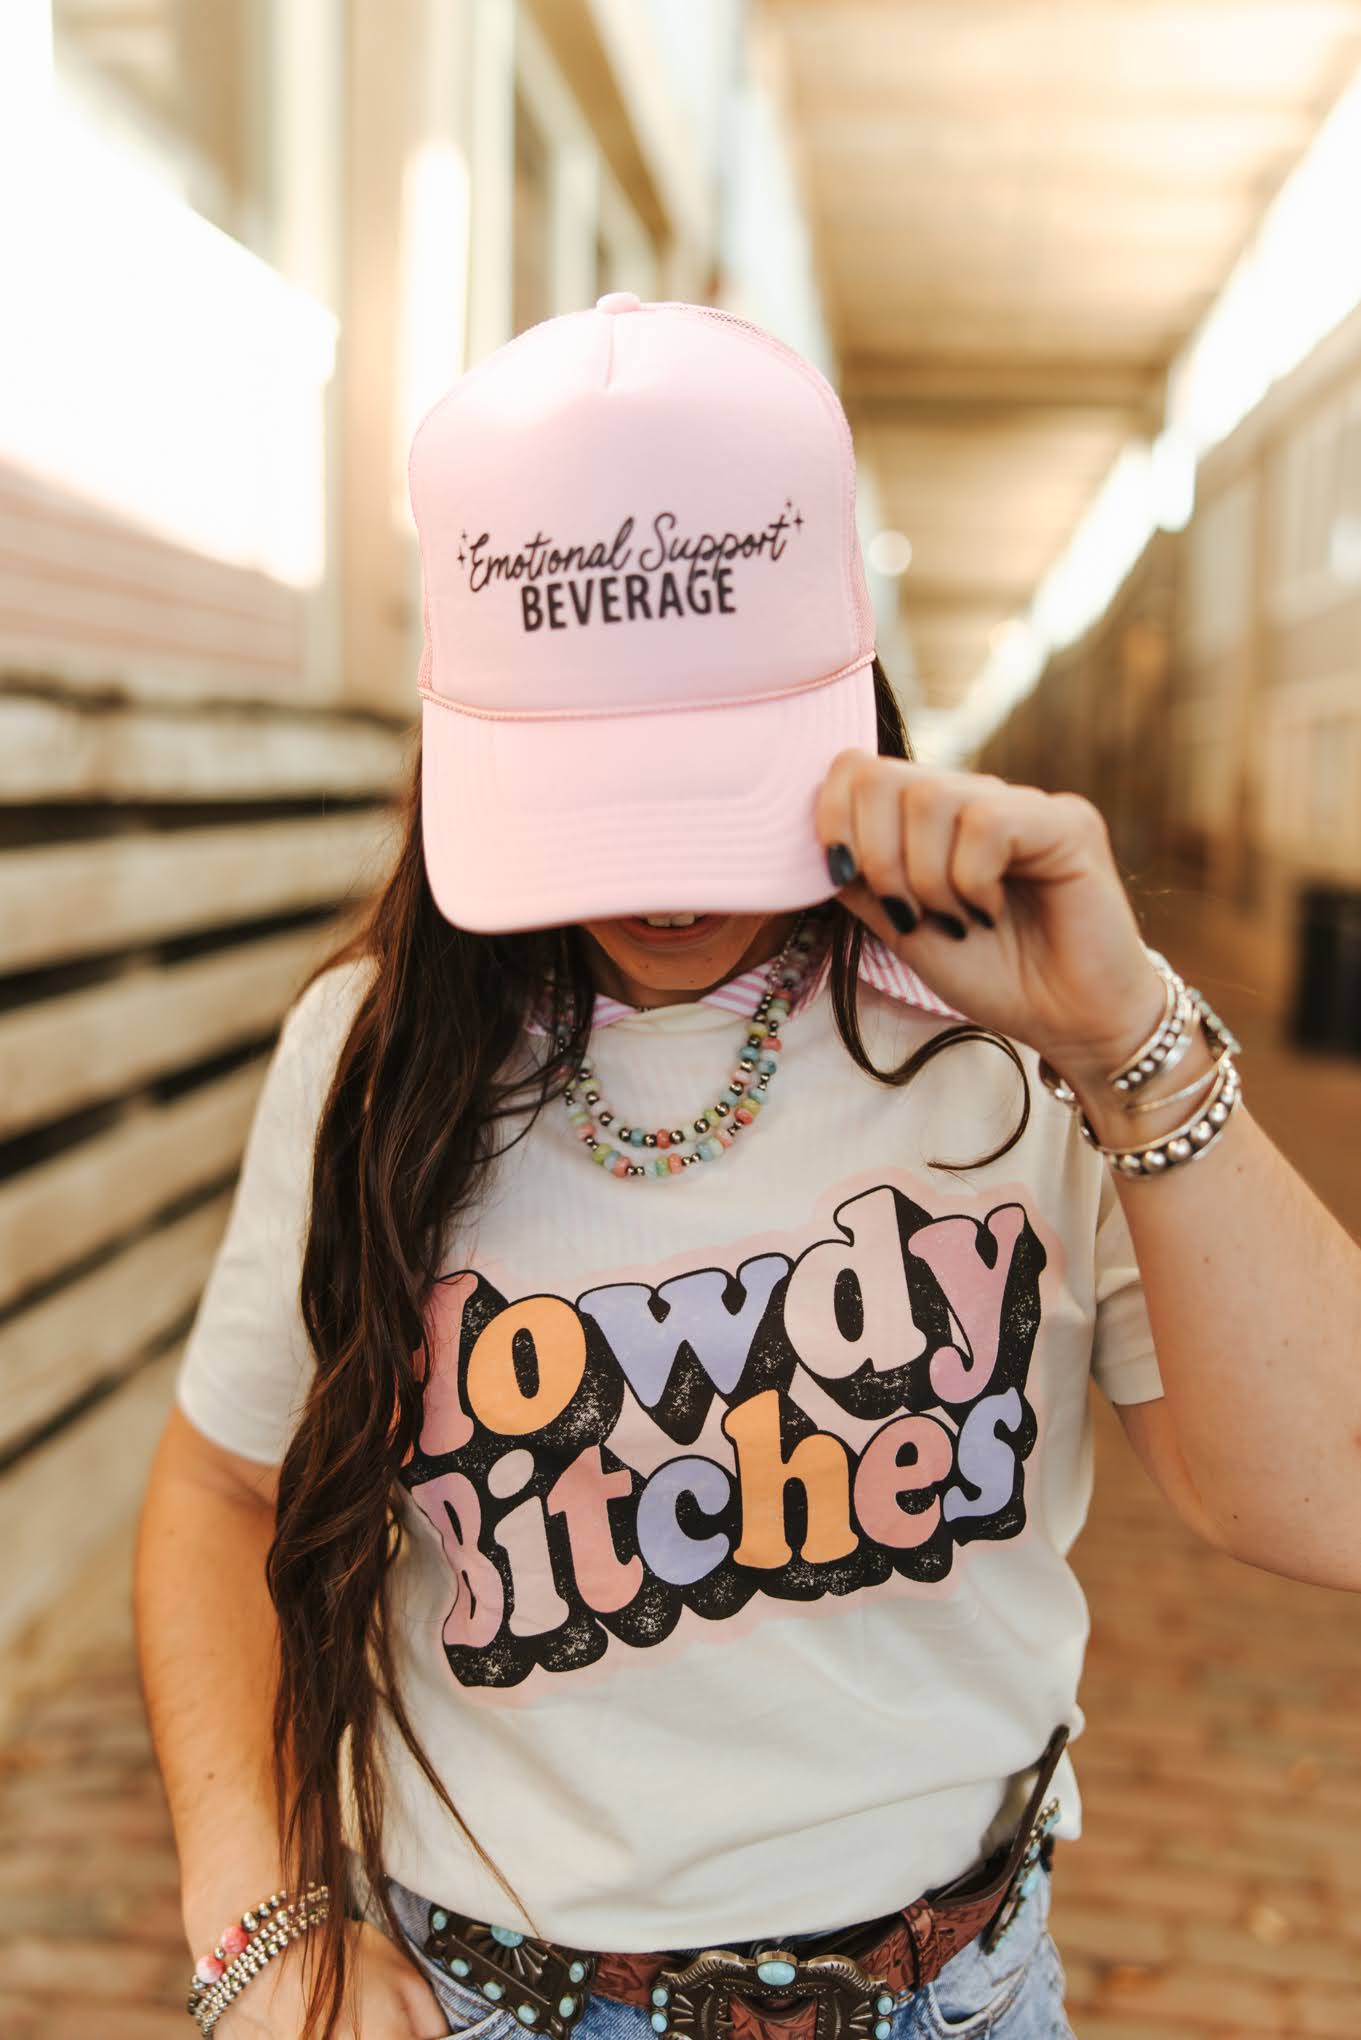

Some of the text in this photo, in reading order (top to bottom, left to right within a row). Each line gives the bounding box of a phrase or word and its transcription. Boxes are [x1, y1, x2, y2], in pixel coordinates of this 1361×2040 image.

[468, 511, 790, 593] Emotional Support
[520, 567, 738, 633] BEVERAGE
